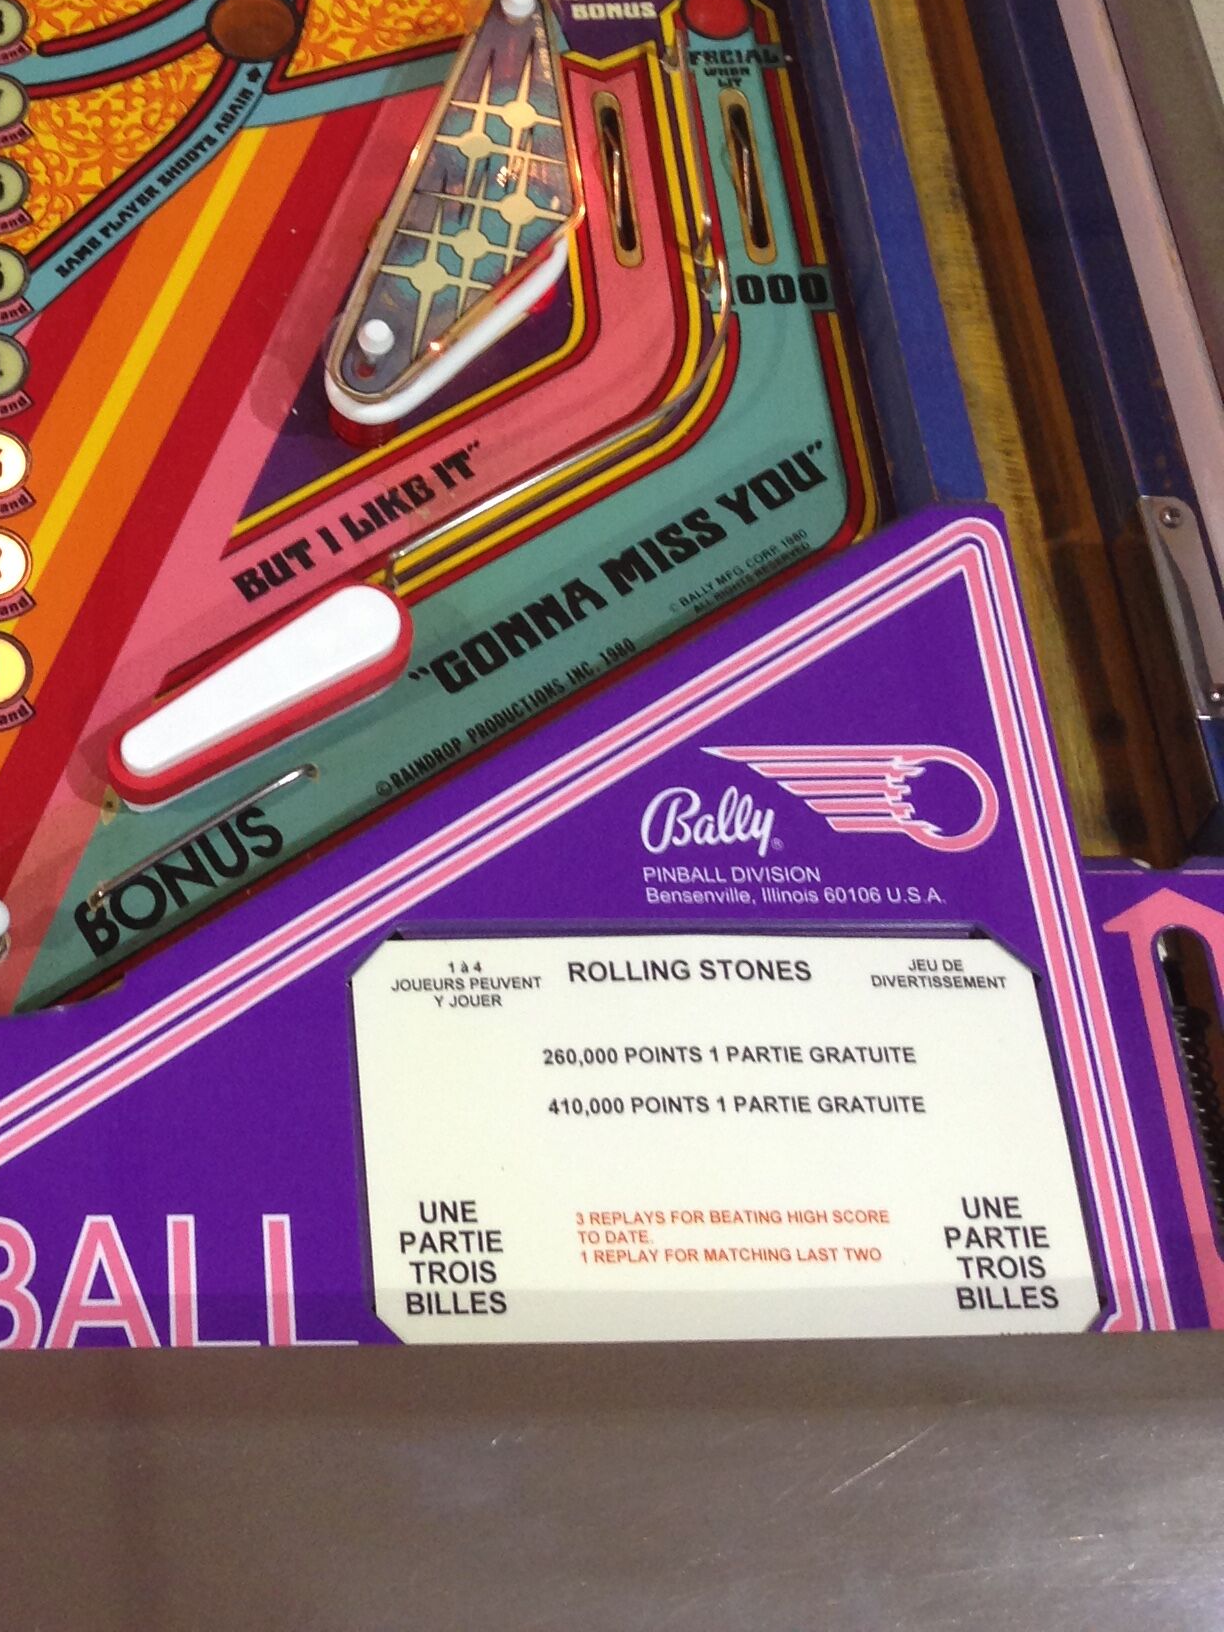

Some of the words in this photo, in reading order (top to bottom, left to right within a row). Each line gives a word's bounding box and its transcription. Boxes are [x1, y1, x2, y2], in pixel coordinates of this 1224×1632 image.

[571, 2, 657, 21] BONUS
[55, 236, 102, 278] SAME
[99, 184, 161, 239] PLAYER
[157, 134, 218, 187] SHOOTS
[214, 87, 254, 135] AGAIN
[230, 540, 315, 606] BUT
[318, 526, 343, 557] I
[337, 476, 438, 543] LIKE
[408, 580, 608, 694] "GONNA
[598, 507, 729, 597] MISS
[716, 440, 827, 530] YOU"
[678, 582, 714, 607] BALLY
[466, 678, 566, 744] PRODUCTIONS
[599, 637, 637, 667] 1980
[640, 785, 775, 857] Bally
[72, 805, 285, 959] BONUS
[643, 866, 726, 884] PINBALL
[730, 866, 821, 882] DIVISION
[645, 886, 756, 905] Bensenville,
[762, 886, 819, 904] Illinois
[824, 887, 882, 904] 60106
[886, 887, 947, 905] U.S.A.
[567, 960, 691, 983] ROLLING
[700, 960, 813, 981] STONES
[908, 959, 938, 972] JEU
[942, 959, 964, 972] DE
[391, 978, 465, 992] JOUEURS
[470, 976, 541, 990] PEUVENT
[871, 975, 1007, 989] DIVERTISSEMENT
[434, 995, 444, 1008] Y
[448, 994, 503, 1008] JOUER
[542, 1048, 618, 1067] 260,000
[625, 1046, 702, 1064] POINTS
[709, 1047, 719, 1062] 1
[726, 1046, 803, 1063] PARTIE
[809, 1046, 917, 1063] GRATUITE
[548, 1097, 624, 1117] 410,000
[631, 1096, 709, 1114] POINTS
[717, 1097, 727, 1112] 1
[733, 1096, 811, 1113] PARTIE
[817, 1096, 926, 1113] GRATUITE
[419, 1200, 478, 1224] UNE
[590, 1211, 665, 1225] REPLAYS
[672, 1211, 704, 1224] FOR
[710, 1210, 782, 1224] BEATING
[787, 1210, 827, 1223] HIGH
[832, 1210, 890, 1224] SCORE
[961, 1197, 1022, 1220] UNE
[398, 1229, 504, 1255] PARTIE
[578, 1231, 600, 1244] TO
[606, 1230, 653, 1244] DATE.
[944, 1226, 1050, 1251] PARTIE
[593, 1249, 658, 1263] REPLAY
[665, 1248, 697, 1262] FOR
[704, 1248, 791, 1262] MATCHING
[797, 1248, 837, 1262] LAST
[844, 1248, 881, 1261] TWO
[410, 1260, 498, 1285] TROIS
[956, 1256, 1047, 1280] TROIS
[406, 1291, 507, 1316] BILLES
[956, 1285, 1060, 1311] BILLES
